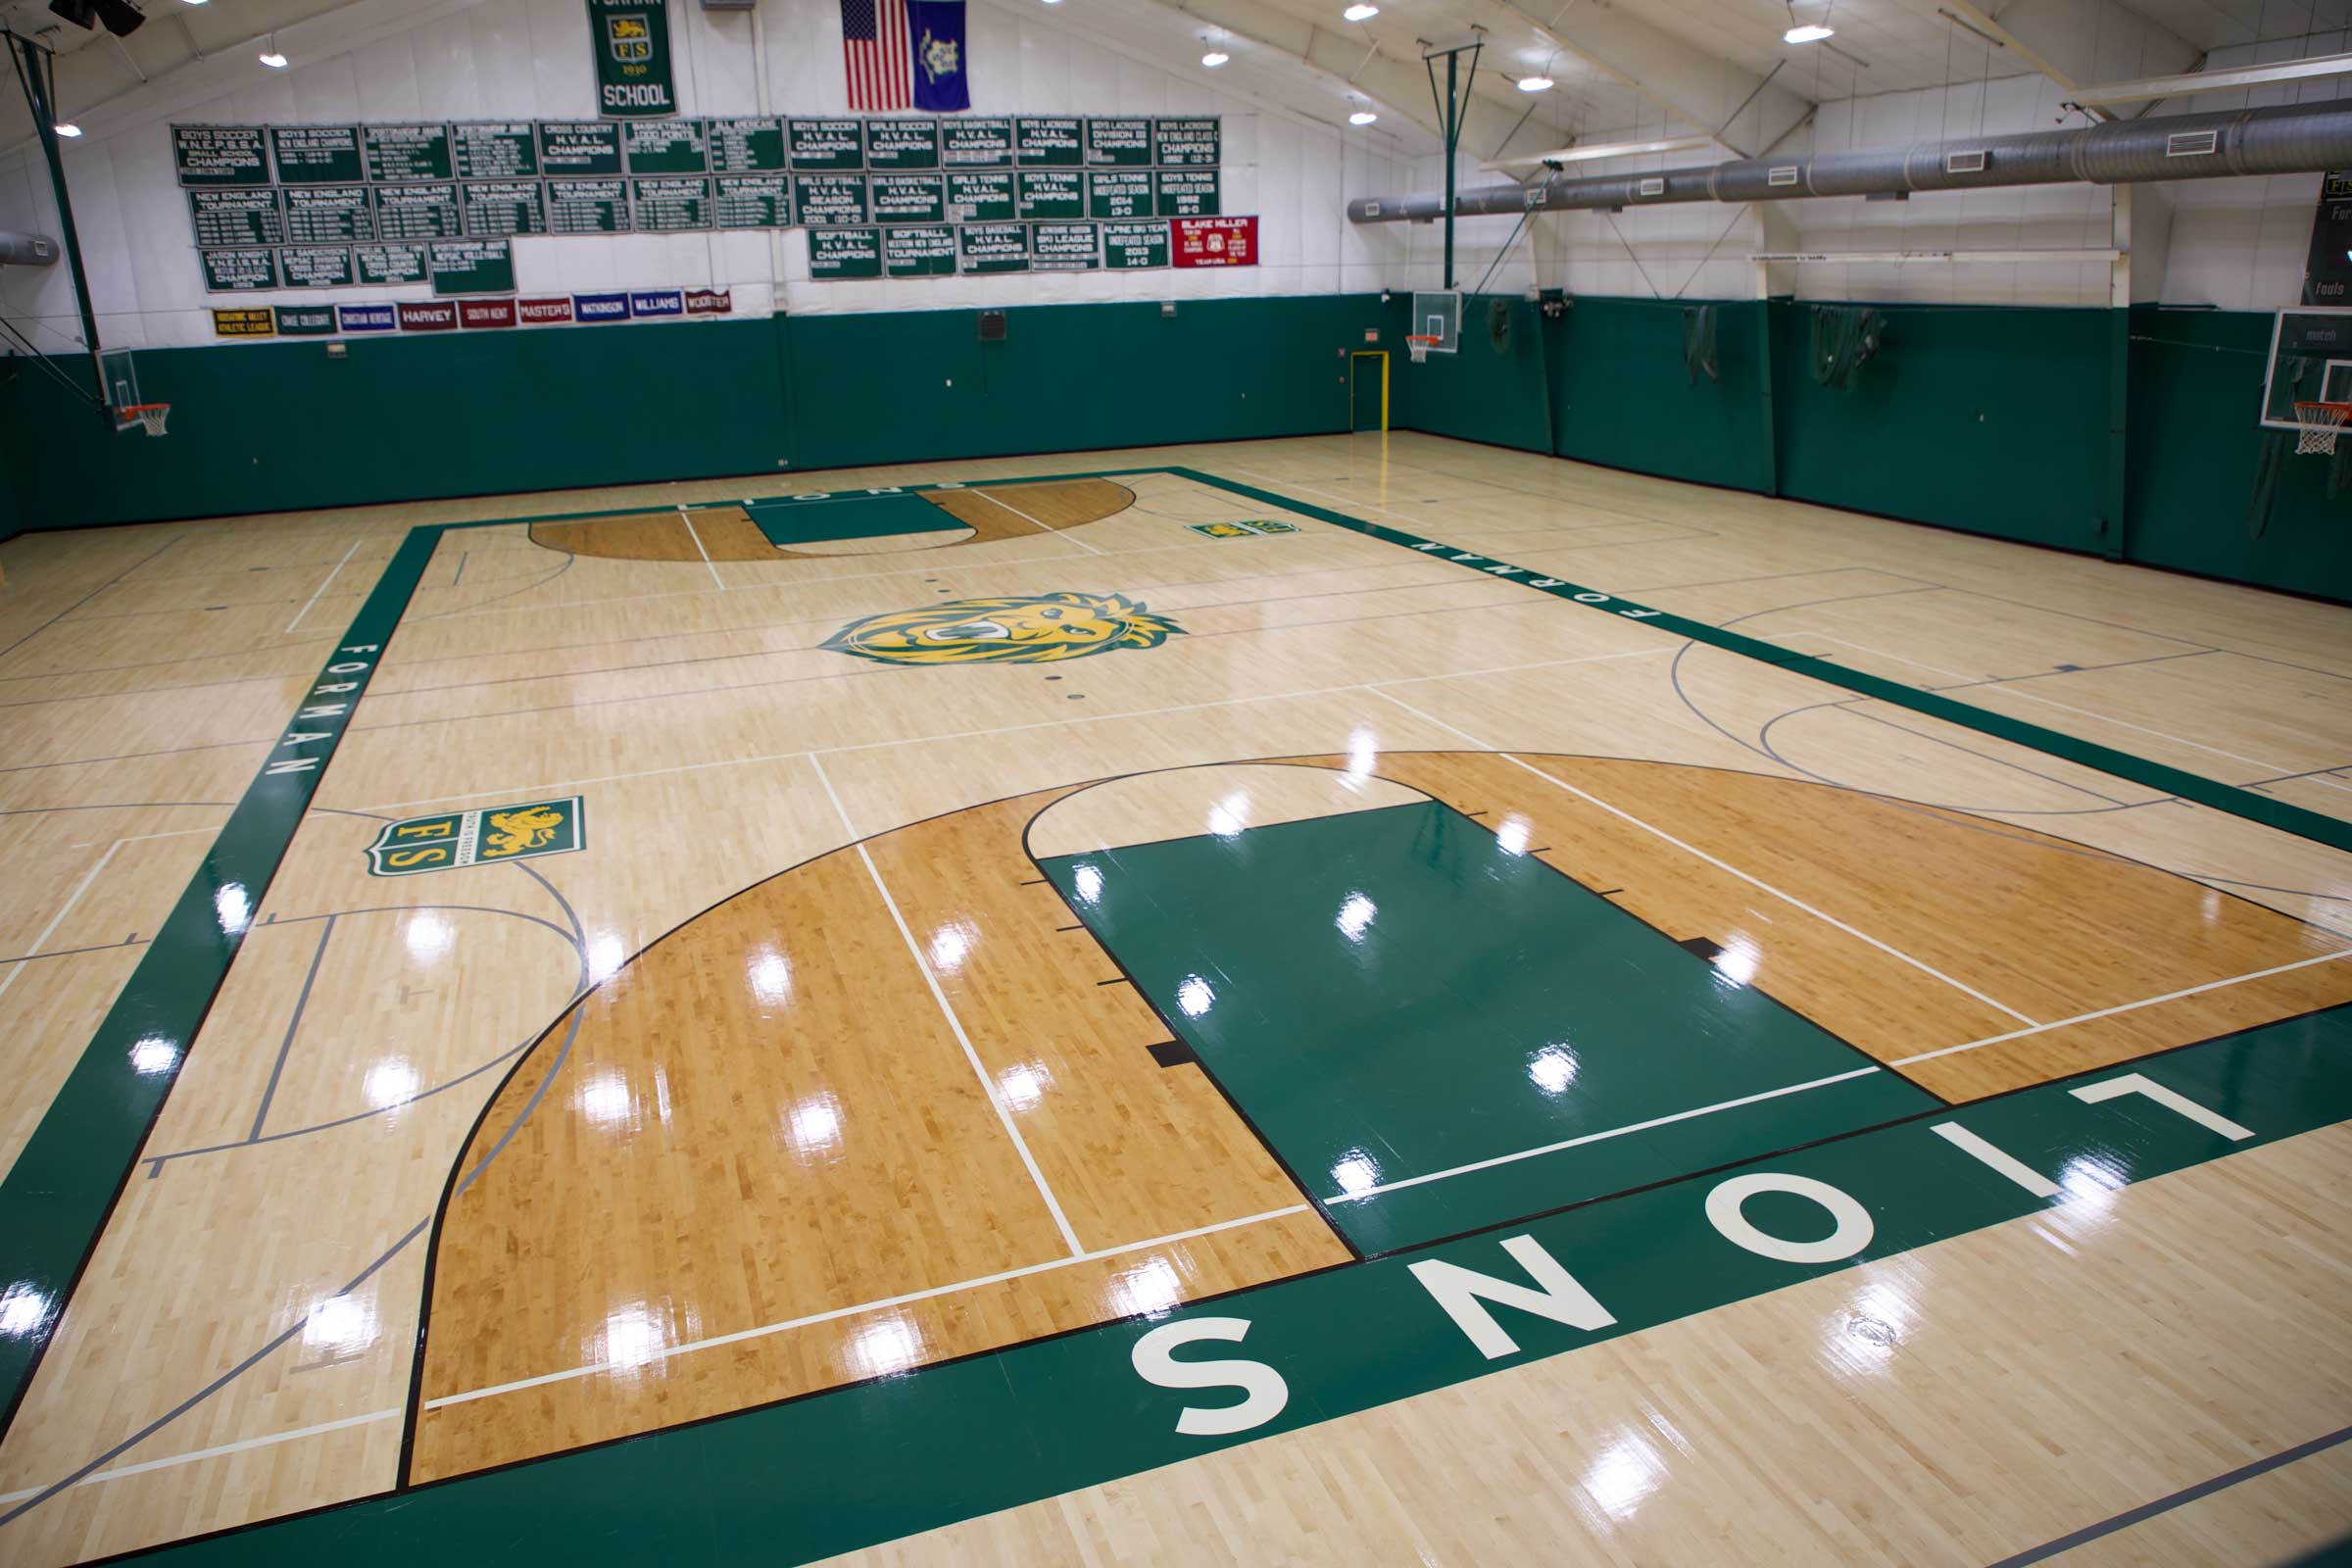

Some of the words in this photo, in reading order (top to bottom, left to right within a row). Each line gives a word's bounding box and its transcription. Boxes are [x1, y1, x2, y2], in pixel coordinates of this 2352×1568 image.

[618, 43, 629, 57] F
[636, 42, 647, 57] S
[604, 84, 671, 106] SCHOOL
[792, 122, 818, 131] BOYS
[820, 122, 858, 131] SOCCER
[180, 130, 211, 139] BOYS
[213, 129, 259, 139] SOCCER
[1093, 129, 1133, 139] DIVISION
[796, 141, 858, 151] CHAMPIONS
[872, 141, 934, 150] CHAMPIONS
[949, 139, 1006, 149] CHAMPIONS
[1022, 138, 1078, 148] CHAMPIONS
[1093, 139, 1147, 148] CHAMPIONS
[1161, 142, 1215, 154] CHAMPIONS
[549, 145, 614, 155] CHAMPIONS
[187, 157, 260, 167] CHAMPIONS
[575, 181, 622, 190] ENGLAND
[660, 178, 705, 187] ENGLAND
[741, 177, 785, 186] ENGLAND
[403, 186, 452, 195] ENGLAND
[490, 183, 537, 192] ENGLAND
[641, 188, 705, 197] TOURNAMENT
[722, 186, 783, 195] TOURNAMENT
[221, 191, 272, 200] ENGLAND
[314, 189, 363, 199] ENGLAND
[469, 192, 537, 201] TOURNAMENT
[556, 190, 622, 199] TOURNAMENT
[954, 193, 1010, 203] CHAMPIONS
[1024, 191, 1079, 201] CHAMPIONS
[291, 198, 364, 209] TOURNAMENT
[381, 195, 452, 204] TOURNAMENT
[809, 195, 855, 205] SEASON
[879, 195, 939, 205] CHAMPIONS
[200, 201, 272, 210] TOURNAMENT
[802, 205, 862, 215] CHAMPIONS
[2331, 206, 2352, 220] For
[1181, 220, 1213, 229] BLAKE
[1214, 218, 1249, 228] MILLER
[892, 228, 948, 239] SOFTBALL
[1104, 224, 1132, 234] ALPINE
[815, 230, 874, 240] SOFTBALL
[1037, 234, 1054, 244] SKI
[1054, 234, 1095, 243] LEAGUE
[888, 247, 956, 258] TOURNAMENT
[967, 244, 1023, 254] CHAMPIONS
[1039, 243, 1093, 253] CHAMPIONS
[816, 250, 876, 260] CHAMPIONS
[292, 271, 345, 280] CHAMPION
[368, 268, 419, 276] CHAMPION
[215, 273, 270, 282] CHAMPION
[2315, 281, 2345, 296] fouls
[635, 297, 679, 311] WILLIAMS
[688, 295, 730, 309] WOOSTER
[403, 309, 452, 322] HARVEY
[1411, 542, 1662, 618] FORMAN
[266, 644, 378, 775] FORMAN
[397, 821, 453, 837] F
[388, 848, 448, 866] S
[1132, 1072, 2256, 1436] LIONS
